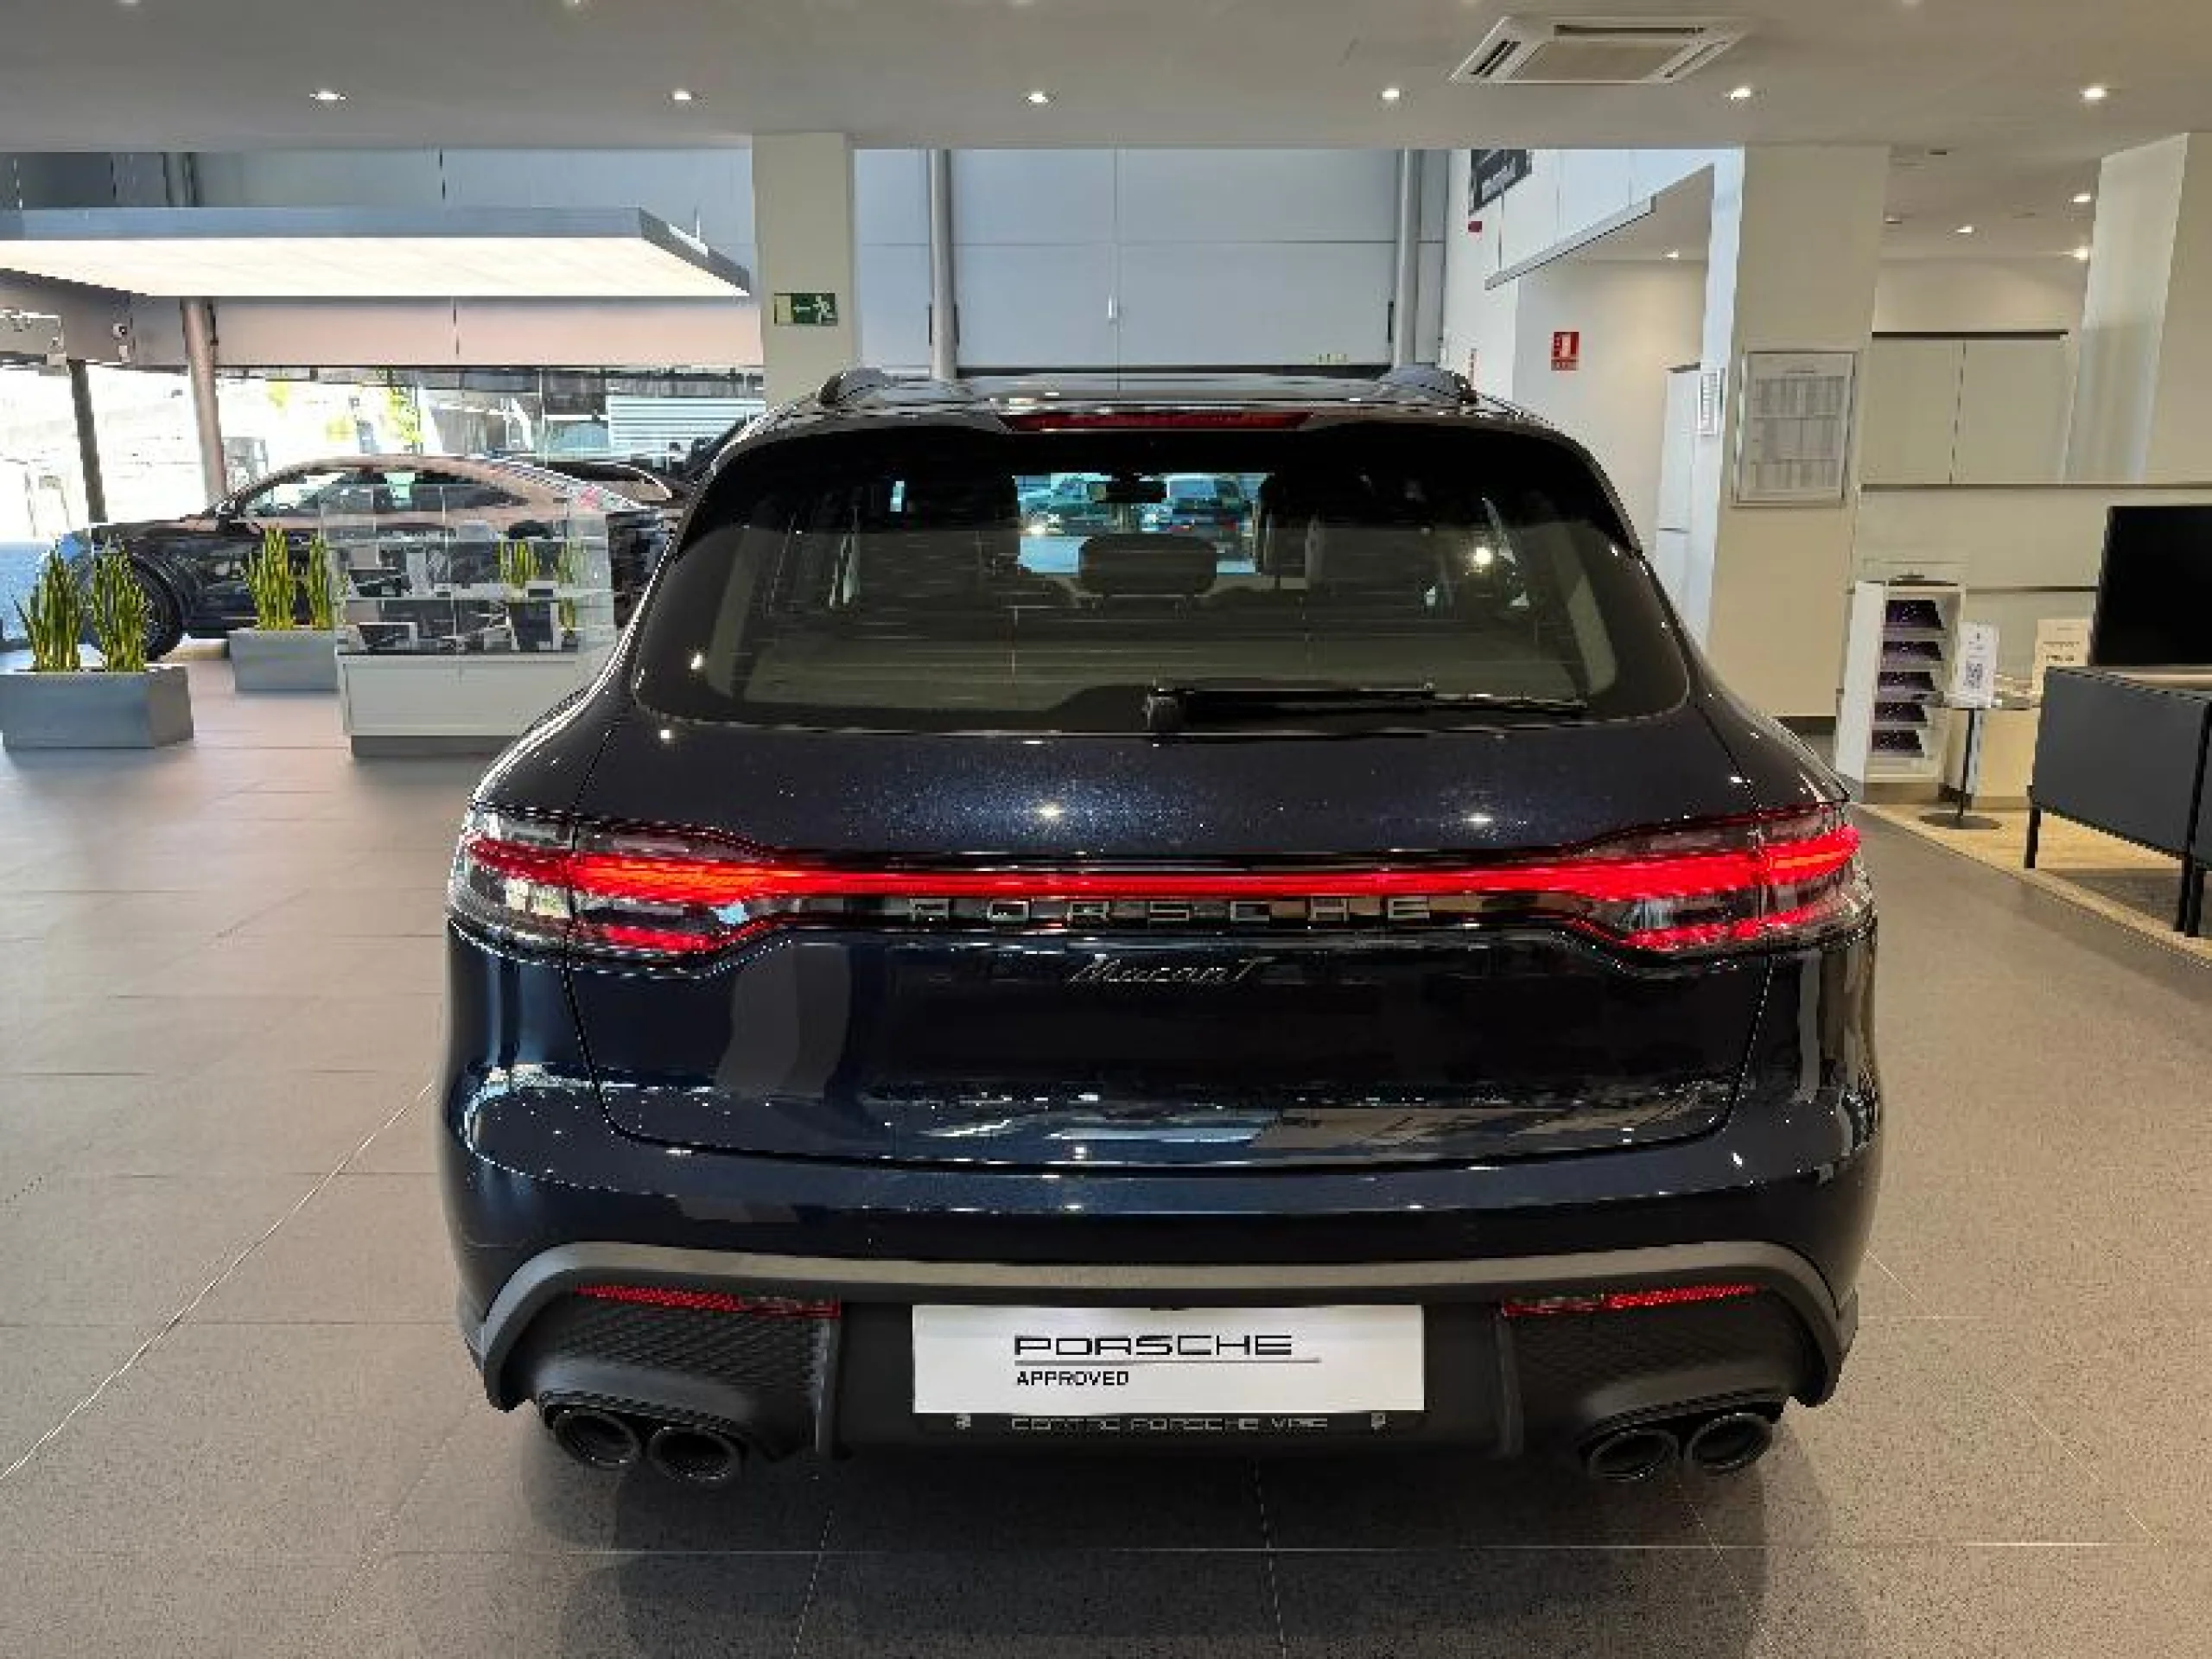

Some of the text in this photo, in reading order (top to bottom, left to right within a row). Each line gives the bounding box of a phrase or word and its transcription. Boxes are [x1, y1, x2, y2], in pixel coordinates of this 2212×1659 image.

[910, 897, 1431, 922] PORSCHE
[1068, 953, 1275, 983] Macan T
[1014, 1335, 1293, 1357] PORSCHE
[1016, 1370, 1130, 1387] APPROVED
[1130, 1417, 1259, 1431] PORSCHE
